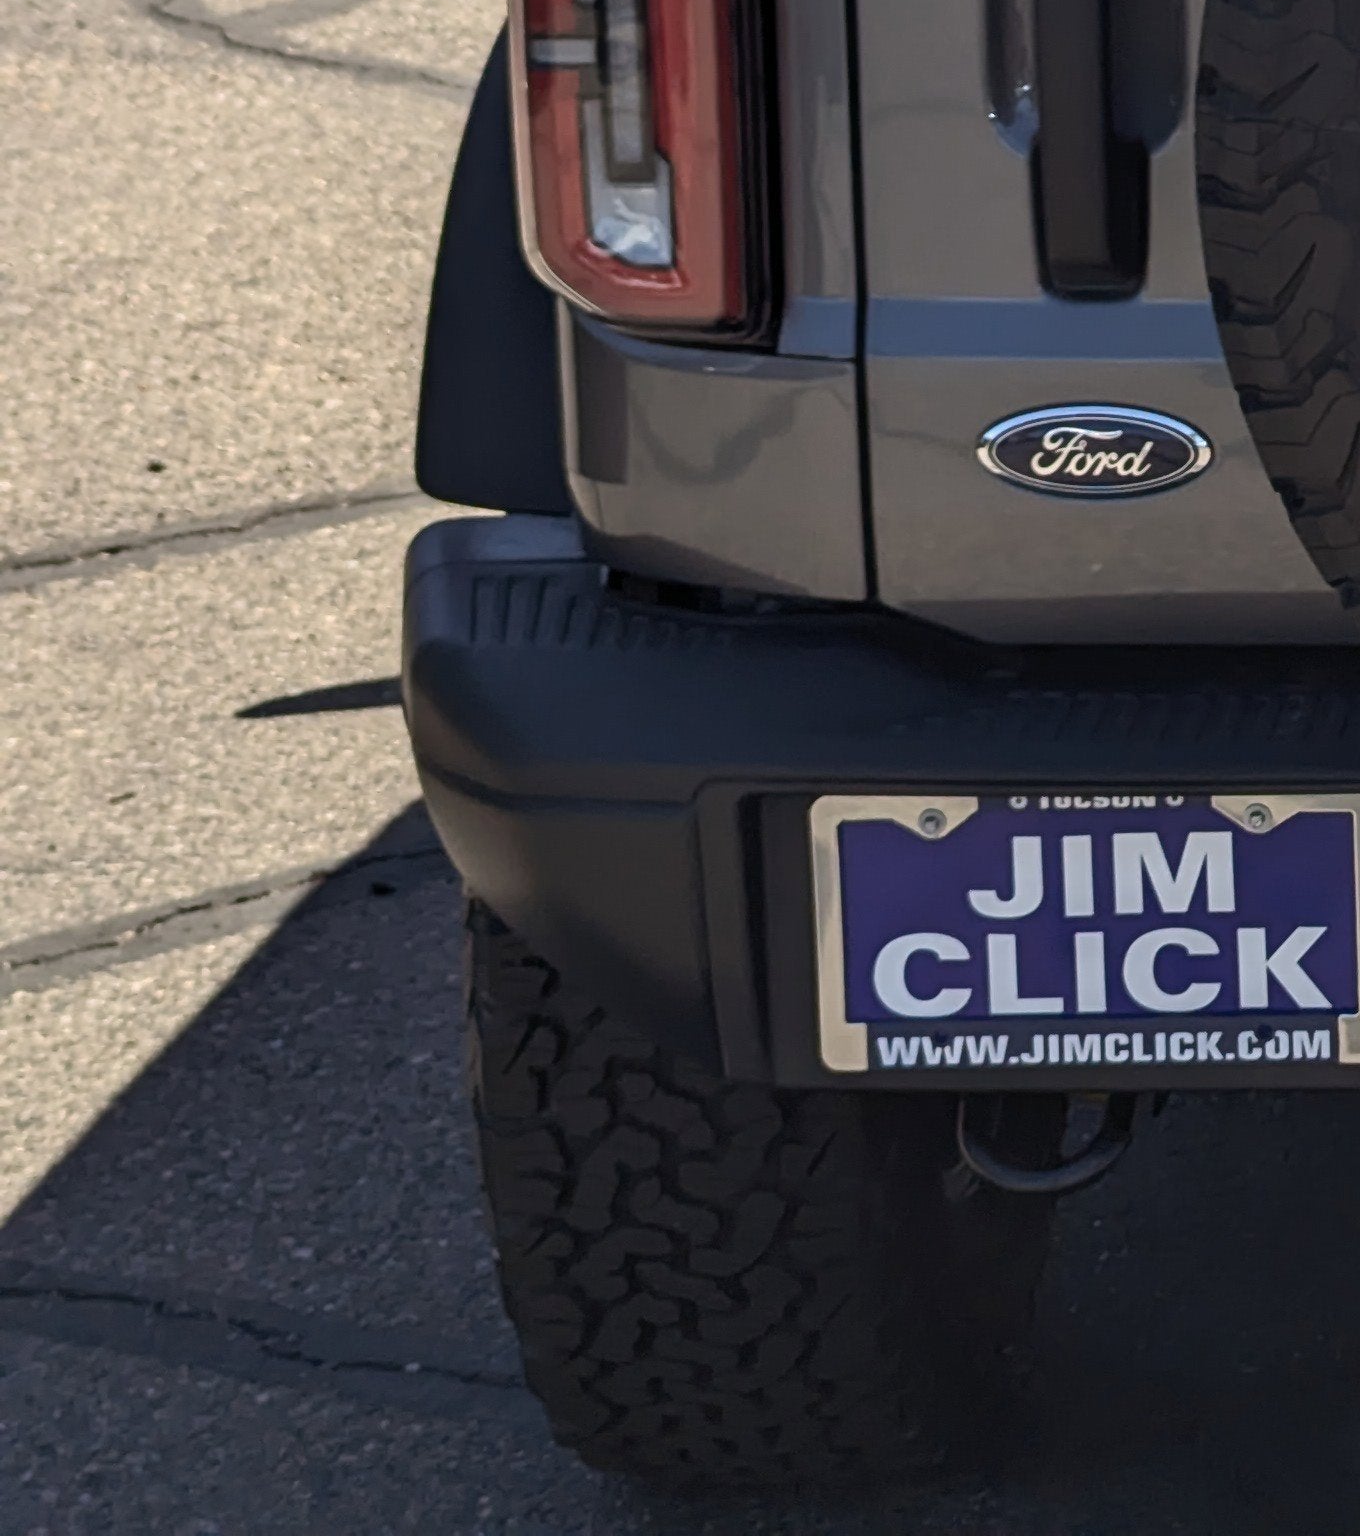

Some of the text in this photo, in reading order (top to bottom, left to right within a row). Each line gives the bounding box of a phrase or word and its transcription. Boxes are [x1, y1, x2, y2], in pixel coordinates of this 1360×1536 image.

[1031, 426, 1153, 477] Ford
[966, 830, 1236, 918] JIM
[872, 926, 1332, 1017] CLICK
[876, 1030, 1331, 1066] WWW.JIMCLICK.COM
